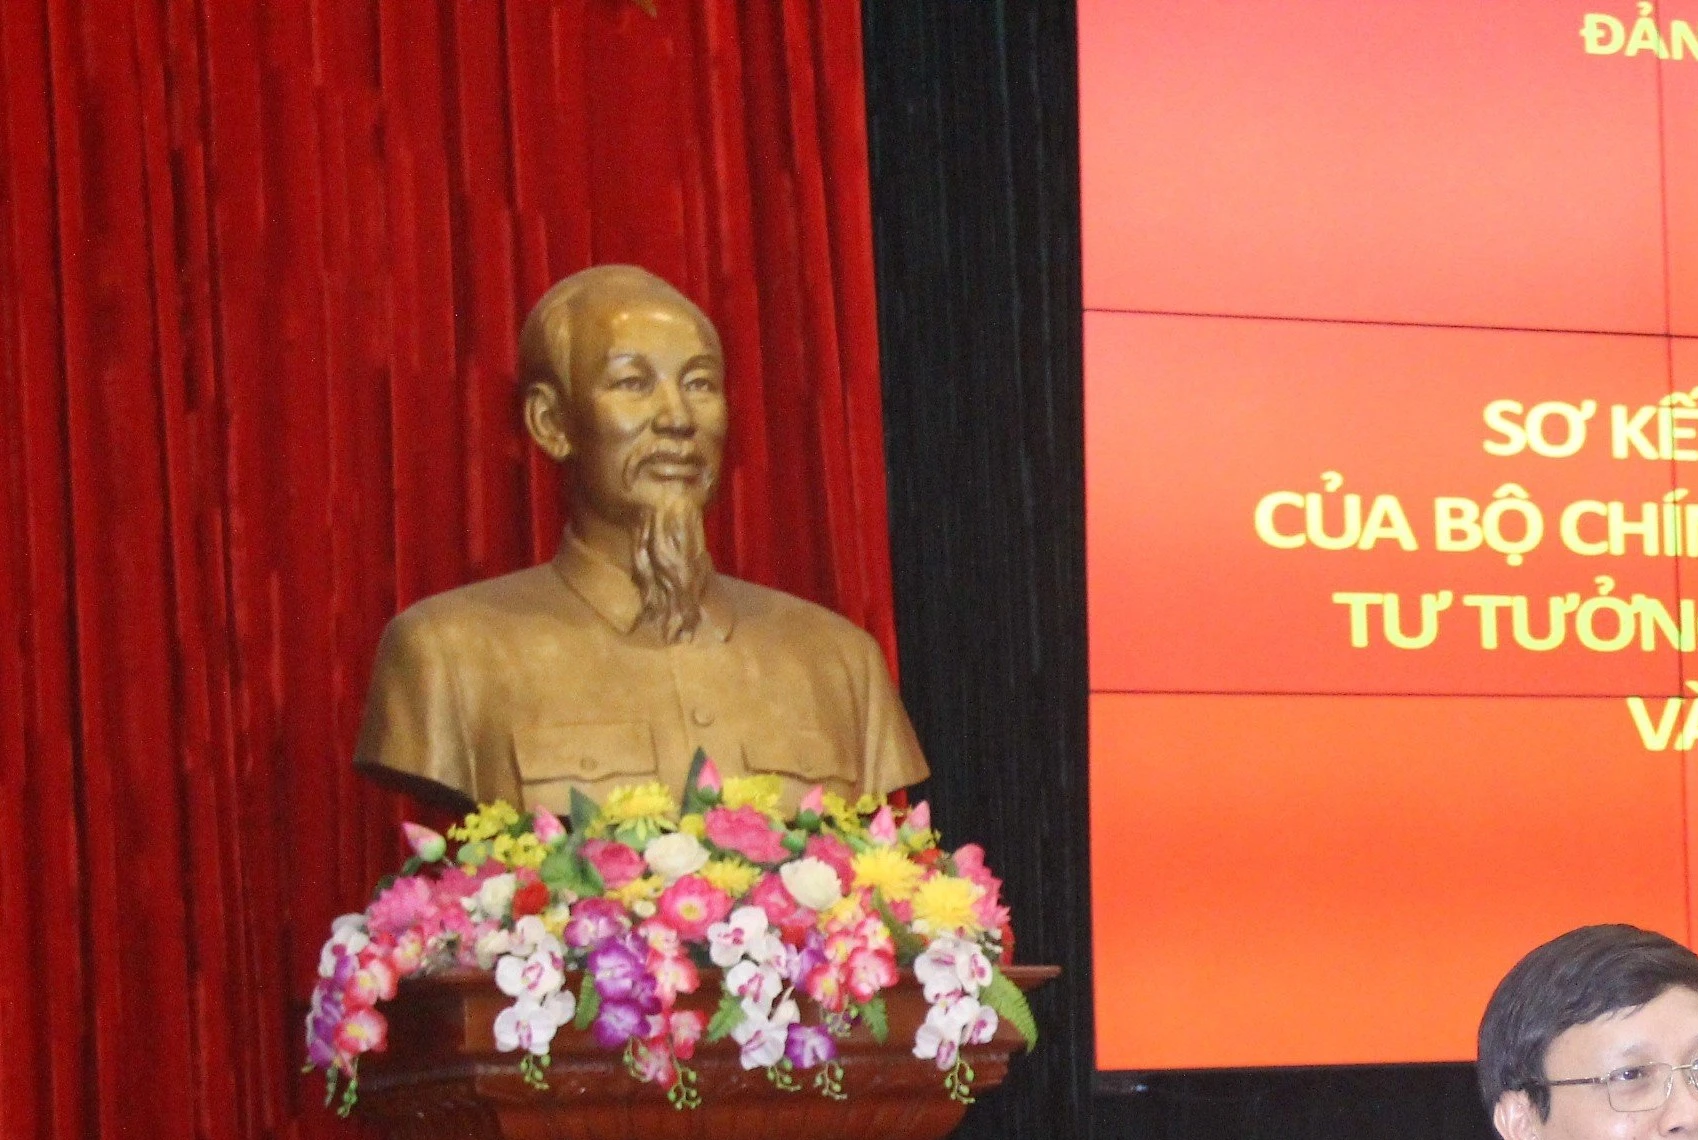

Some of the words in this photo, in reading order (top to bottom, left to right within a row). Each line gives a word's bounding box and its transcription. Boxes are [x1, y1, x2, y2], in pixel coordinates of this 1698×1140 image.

[1483, 400, 1597, 457] SƠ
[1255, 471, 1418, 551] CỦA
[1434, 483, 1544, 566] BỘ
[1332, 590, 1453, 649] TƯ
